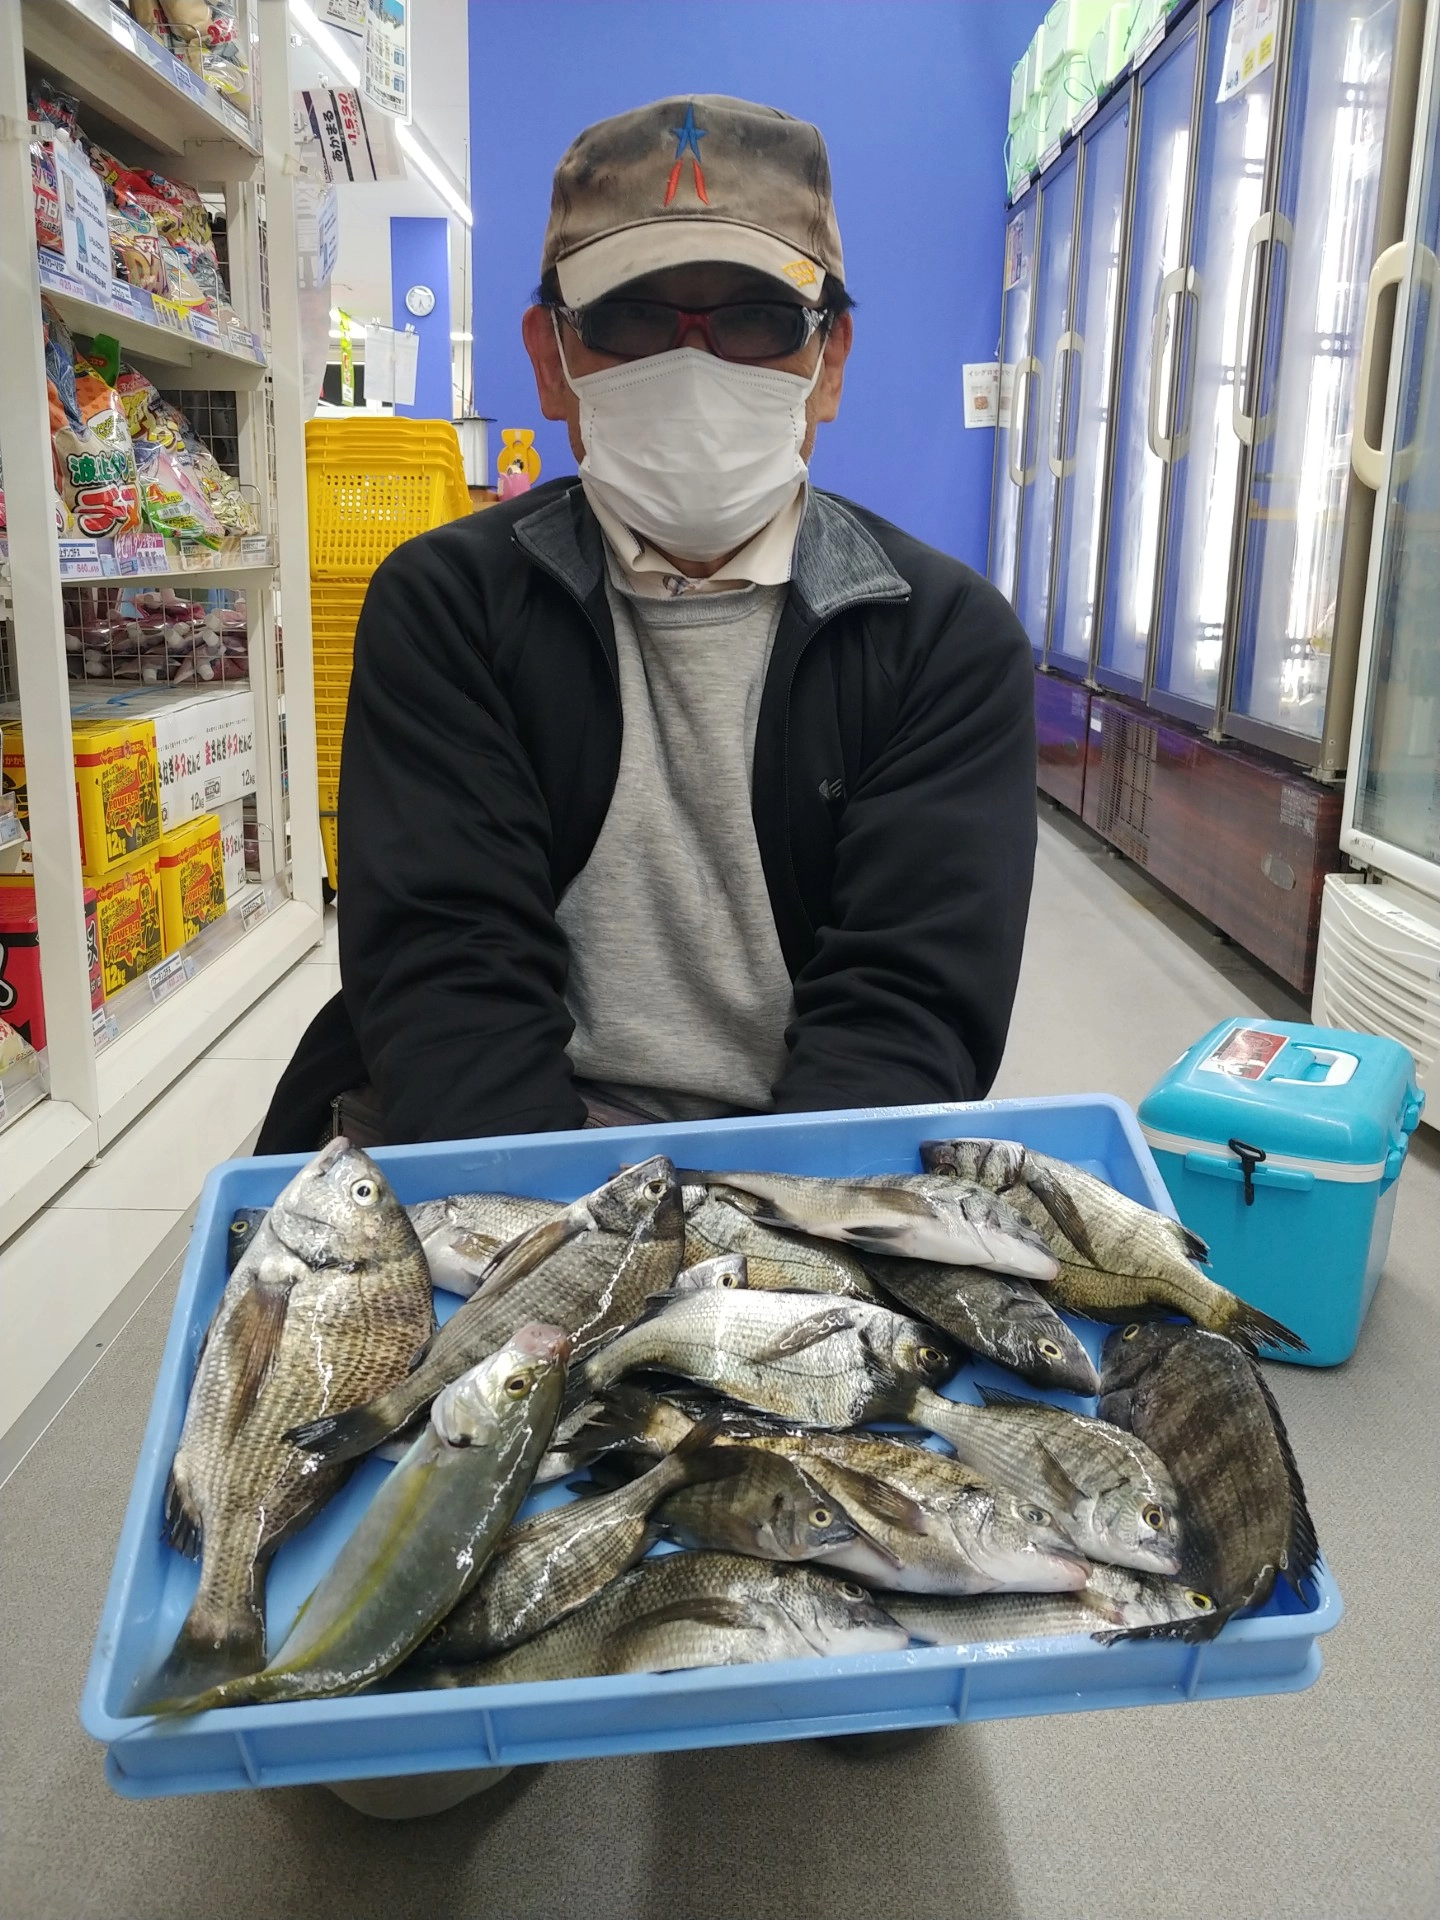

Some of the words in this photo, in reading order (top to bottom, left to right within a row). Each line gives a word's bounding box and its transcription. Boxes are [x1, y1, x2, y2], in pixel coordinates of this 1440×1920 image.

[322, 109, 343, 162] あかまる
[242, 768, 256, 786] 12kg
[190, 792, 205, 811] 12kg
[107, 831, 127, 859] 12kg
[107, 919, 141, 945] POWER-D
[105, 964, 126, 992] 12kg
